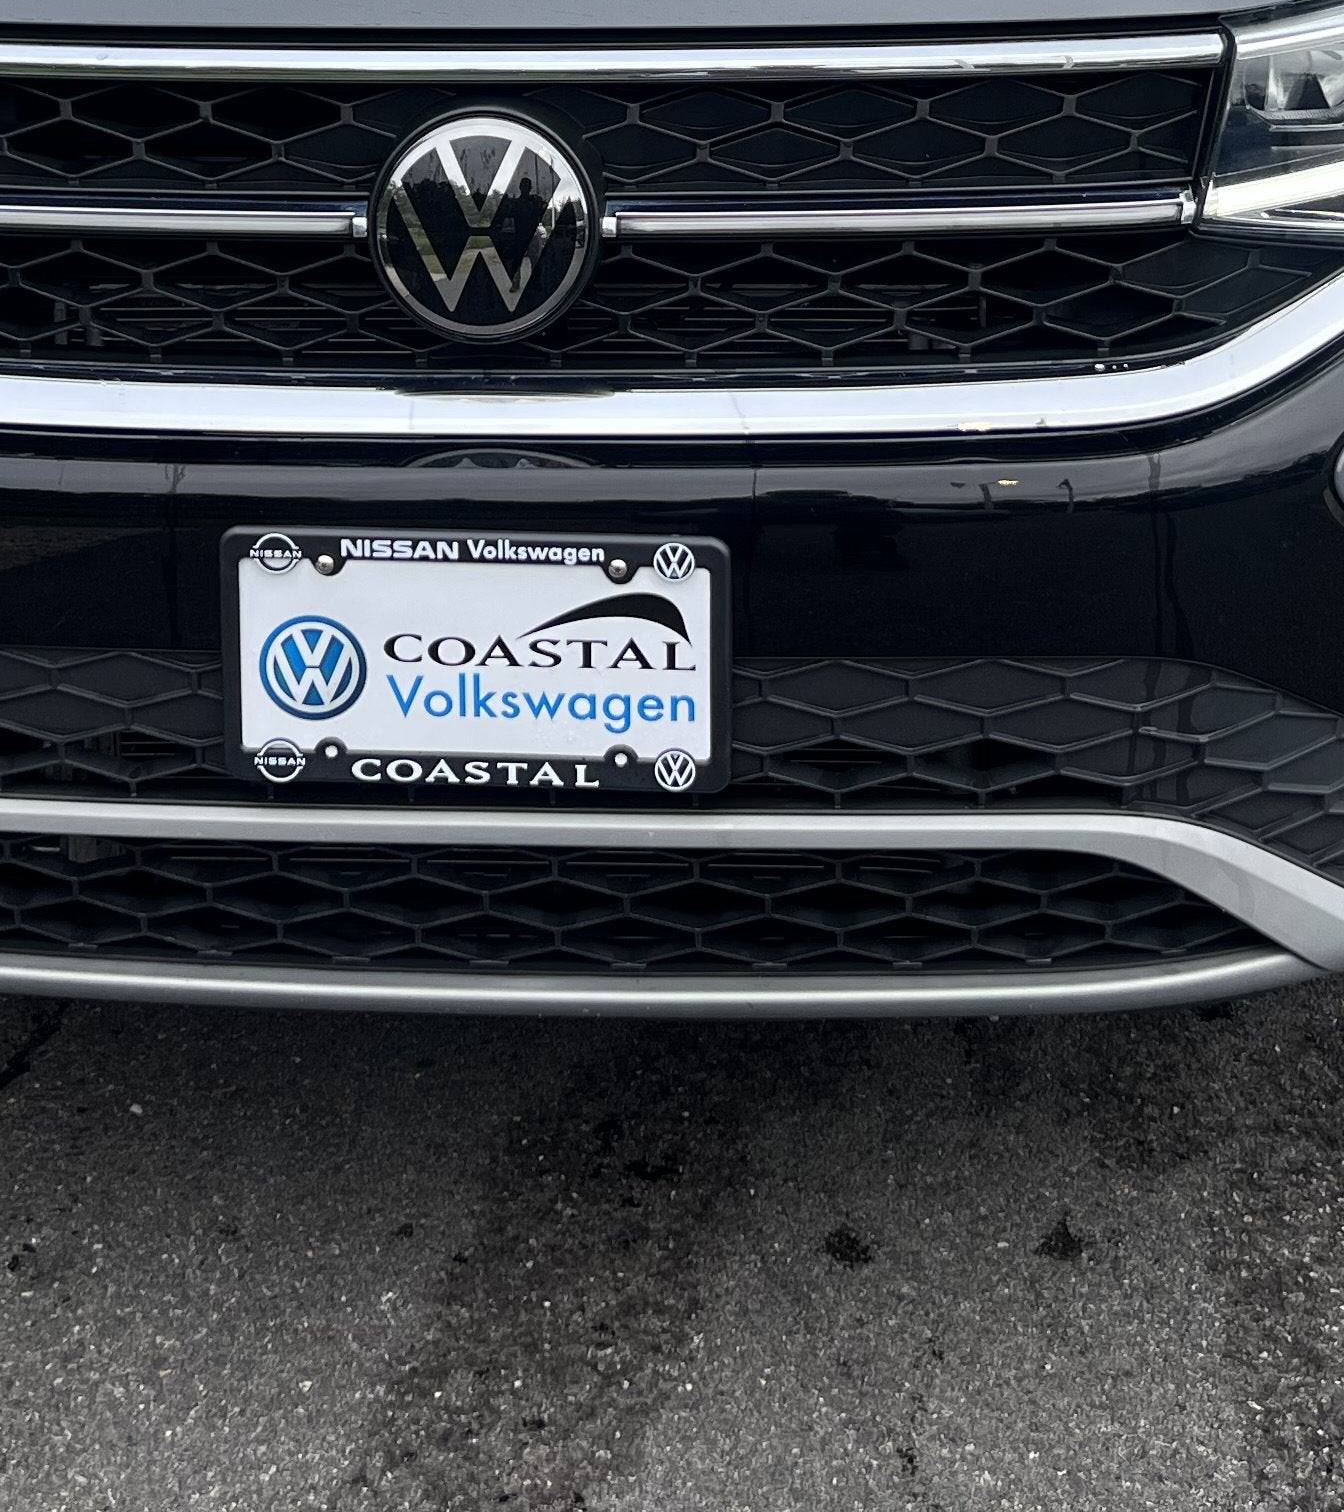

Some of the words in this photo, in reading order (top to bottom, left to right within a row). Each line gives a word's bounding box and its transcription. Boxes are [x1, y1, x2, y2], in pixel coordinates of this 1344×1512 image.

[249, 549, 302, 558] NISSAN
[340, 538, 459, 560] NISSAN
[467, 539, 605, 566] Volkswagen
[383, 633, 697, 672] COASTAL
[386, 674, 696, 734] Volkswagen
[254, 756, 306, 766] NISSAN
[351, 758, 600, 788] COASTAL
